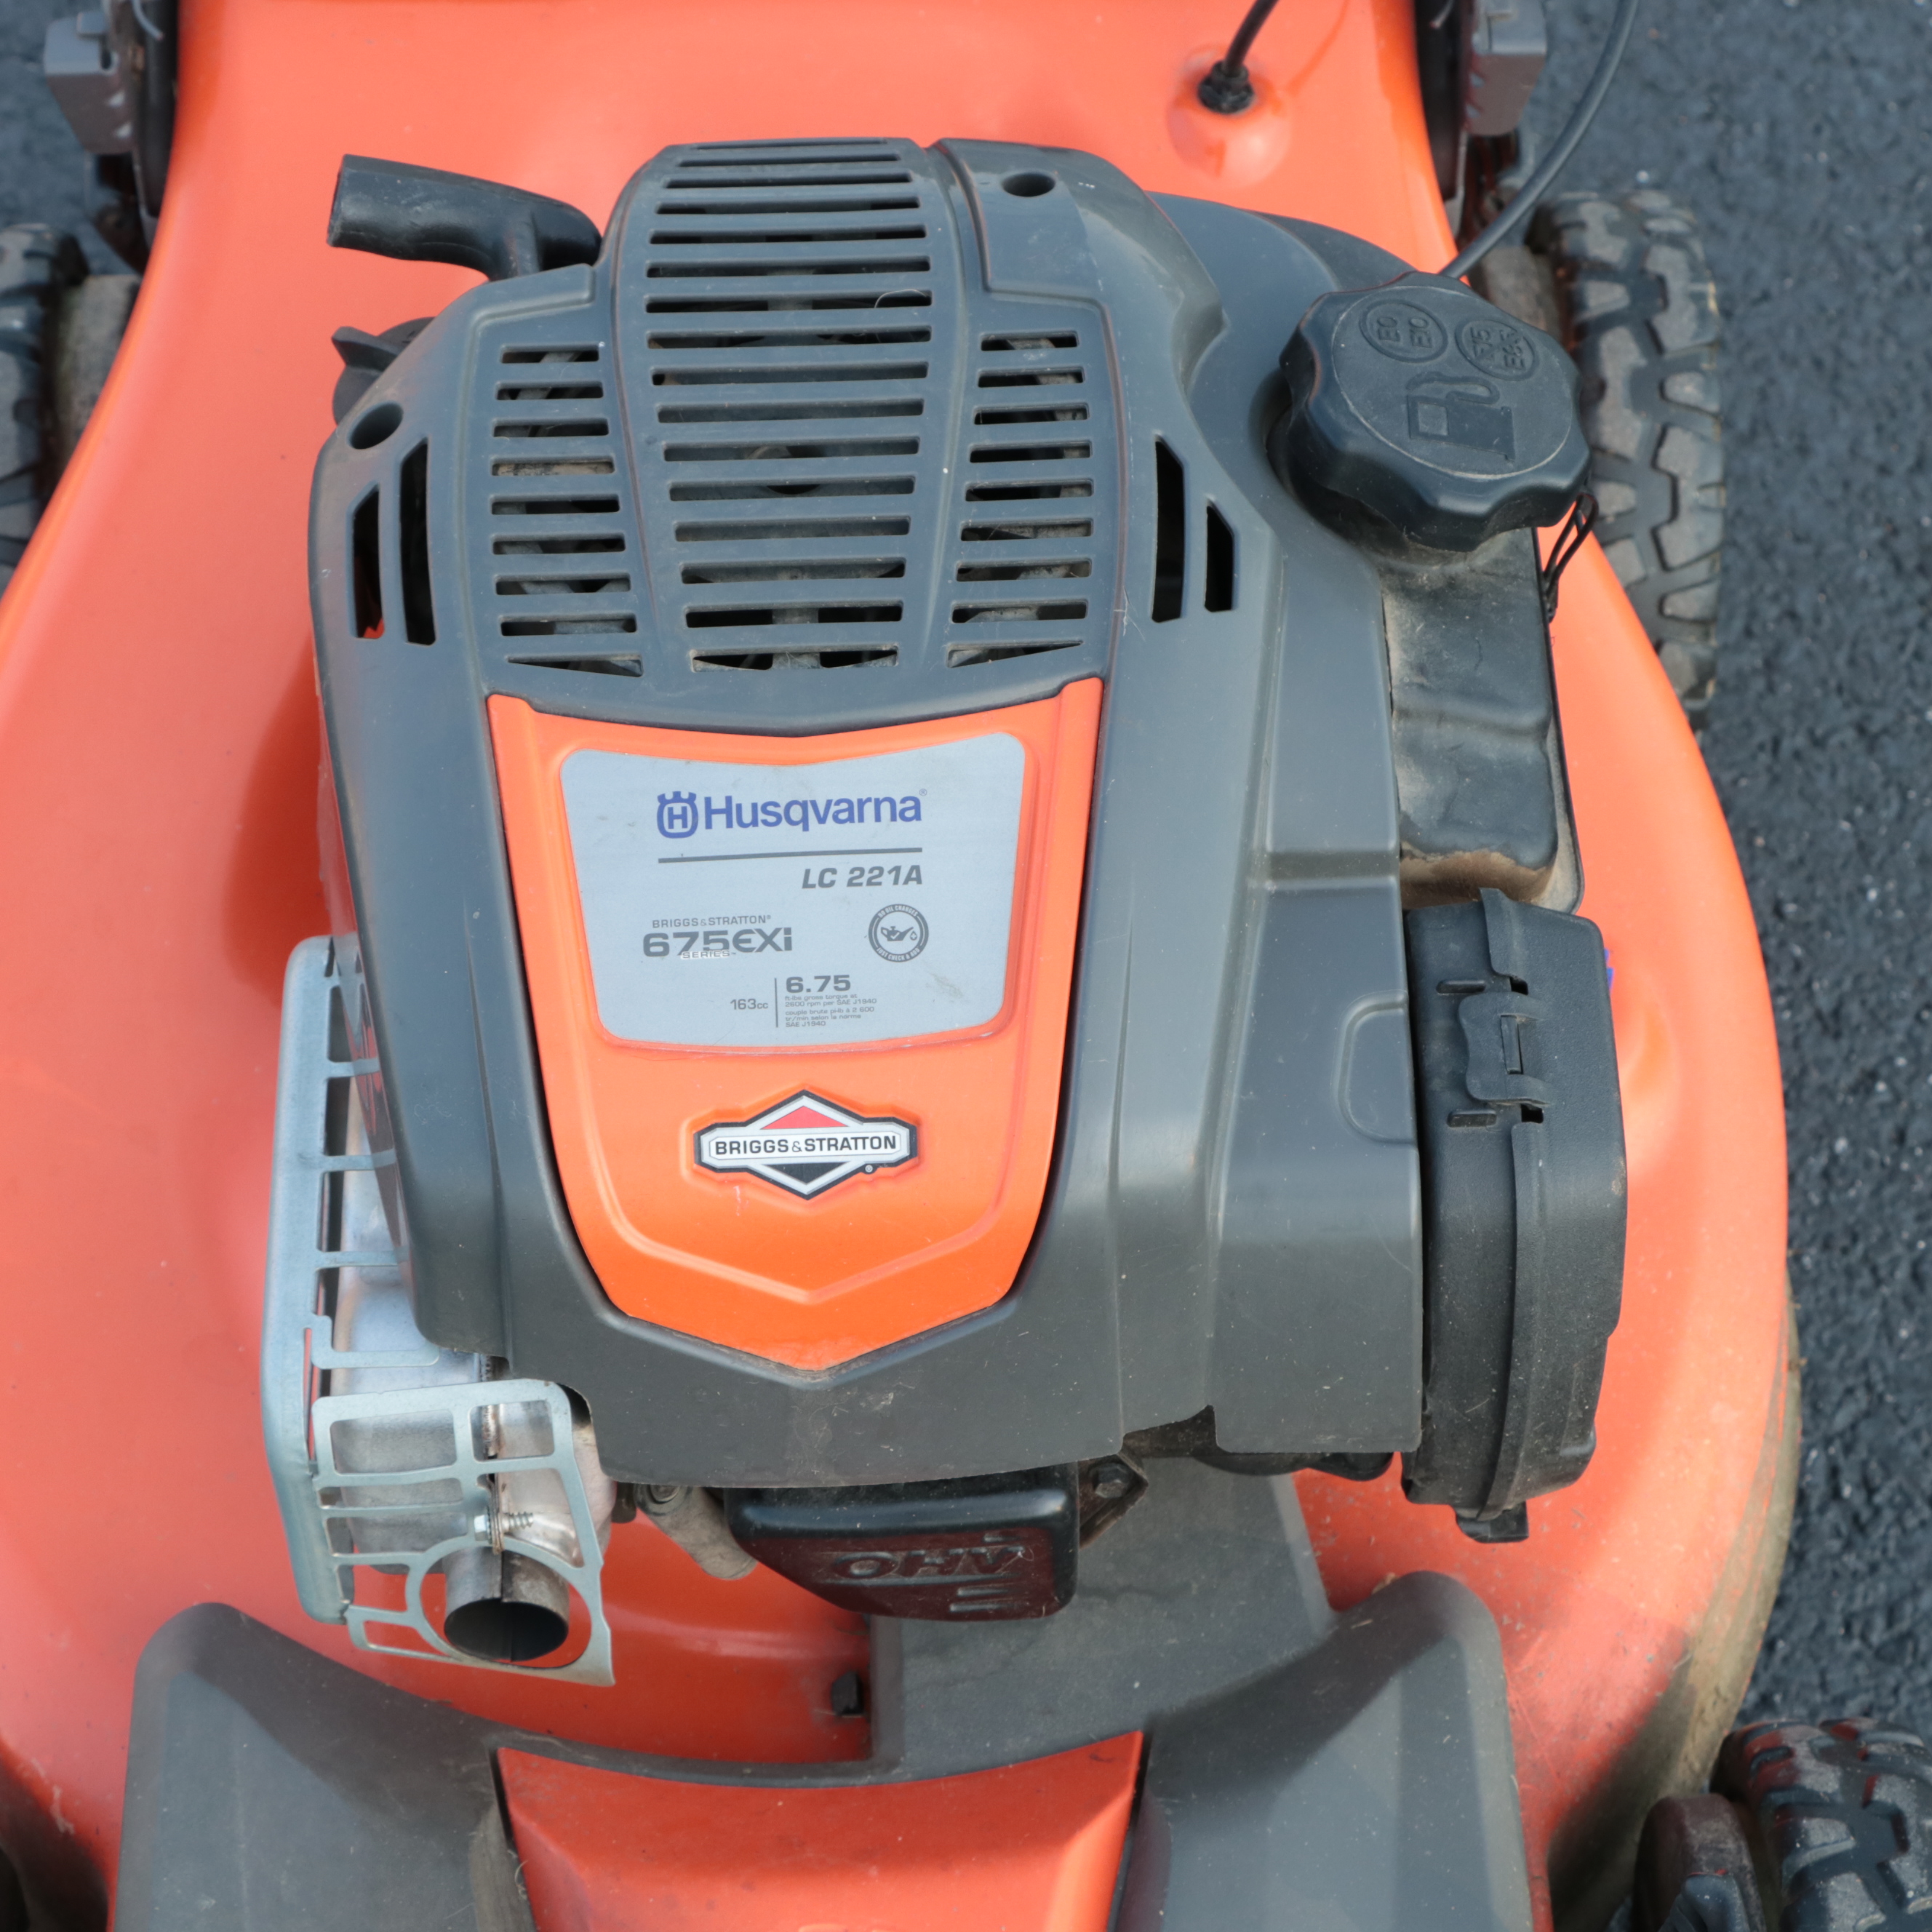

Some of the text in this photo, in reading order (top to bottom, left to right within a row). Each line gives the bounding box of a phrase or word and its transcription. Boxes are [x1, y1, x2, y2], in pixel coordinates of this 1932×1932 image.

[704, 795, 922, 831] Husqvarna
[802, 865, 922, 889] LC 221A
[682, 950, 730, 959] SERIES
[786, 975, 851, 993] 6.75
[730, 998, 768, 1010] 163cc
